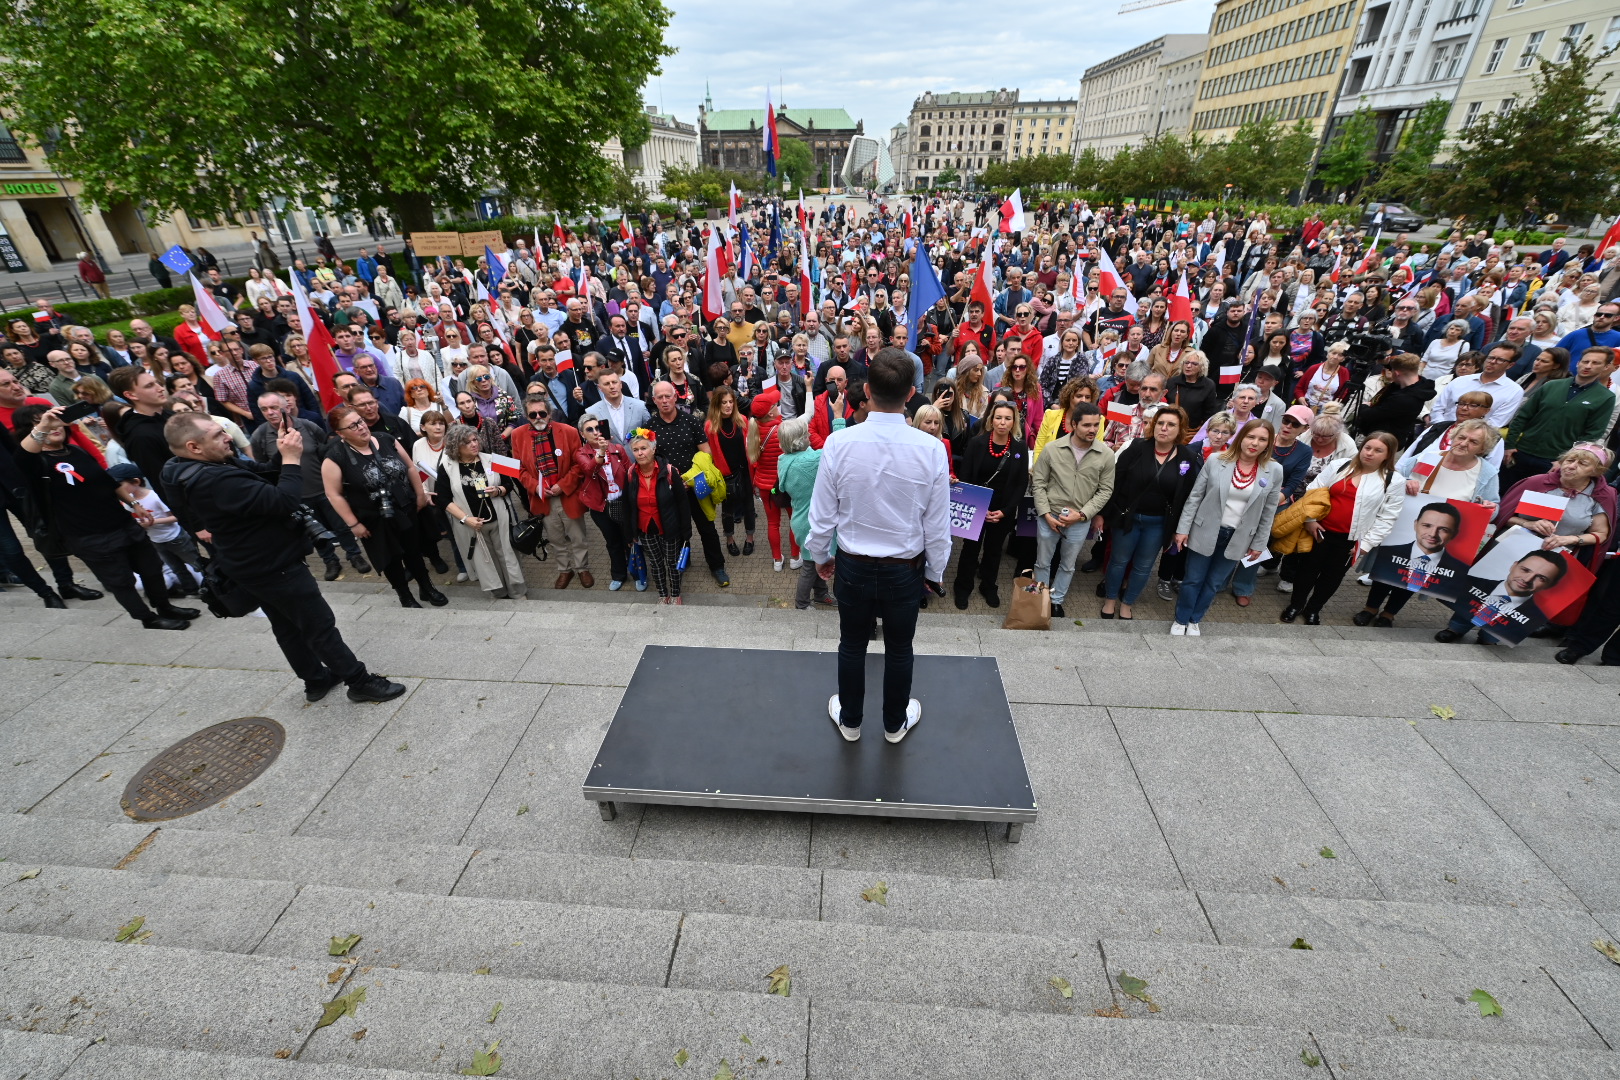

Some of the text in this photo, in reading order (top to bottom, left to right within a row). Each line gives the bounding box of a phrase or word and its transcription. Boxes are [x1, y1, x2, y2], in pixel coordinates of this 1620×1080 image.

[3, 183, 60, 195] HOTELS
[949, 501, 977, 515] #TRZ
[1027, 507, 1037, 515] K
[950, 518, 972, 531] KO
[1391, 555, 1455, 578] TRZASKOWSKI
[1468, 586, 1530, 625] TRZASKOWSKI
